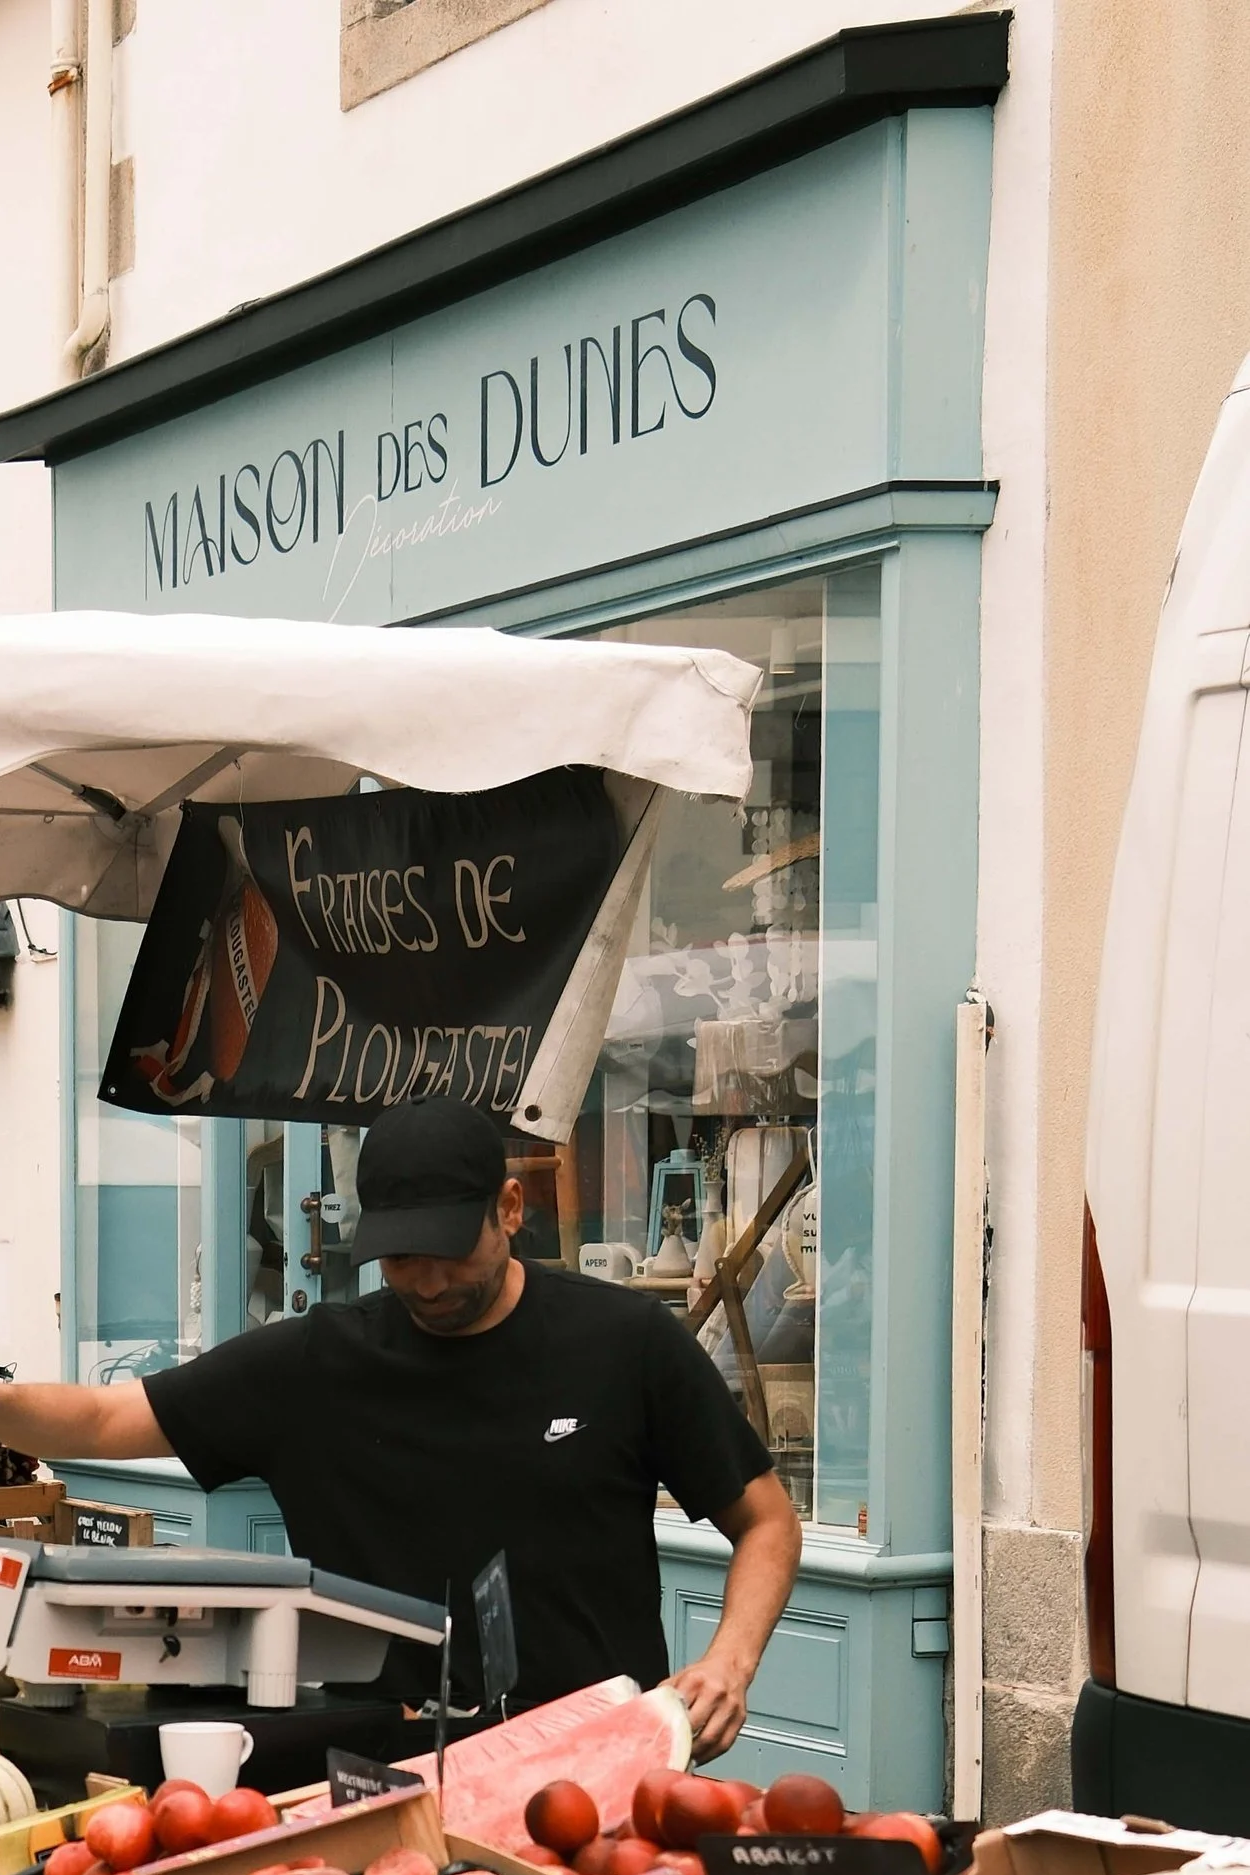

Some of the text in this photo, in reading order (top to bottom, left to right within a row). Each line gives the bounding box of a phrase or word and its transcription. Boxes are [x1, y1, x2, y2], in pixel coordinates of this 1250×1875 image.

[145, 293, 717, 600] MAISON DES DUNES
[285, 826, 526, 954] FRAISES DE
[229, 908, 258, 1026] LOUGASTEL
[293, 976, 532, 1112] PLOUGASTEL
[585, 1258, 608, 1268] APERO
[550, 1418, 578, 1433] NIKE
[69, 1653, 102, 1668] ABM
